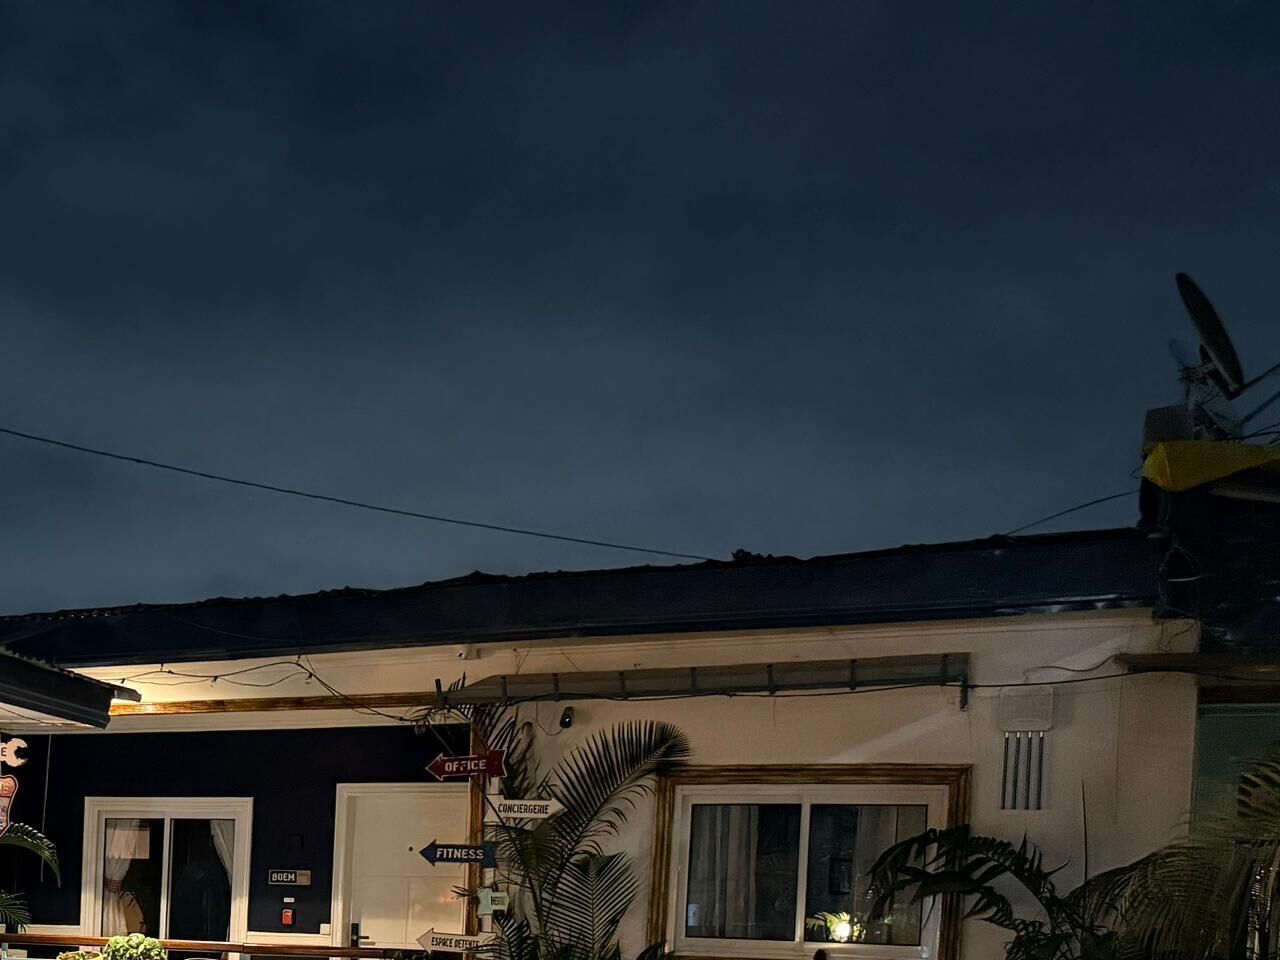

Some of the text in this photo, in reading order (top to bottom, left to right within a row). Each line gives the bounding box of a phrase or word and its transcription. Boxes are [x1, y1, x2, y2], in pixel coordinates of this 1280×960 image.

[444, 758, 488, 773] OFFICE
[497, 802, 551, 816] CONCIERGERIE
[435, 846, 485, 860] FITNESS
[431, 936, 453, 948] ESPACE
